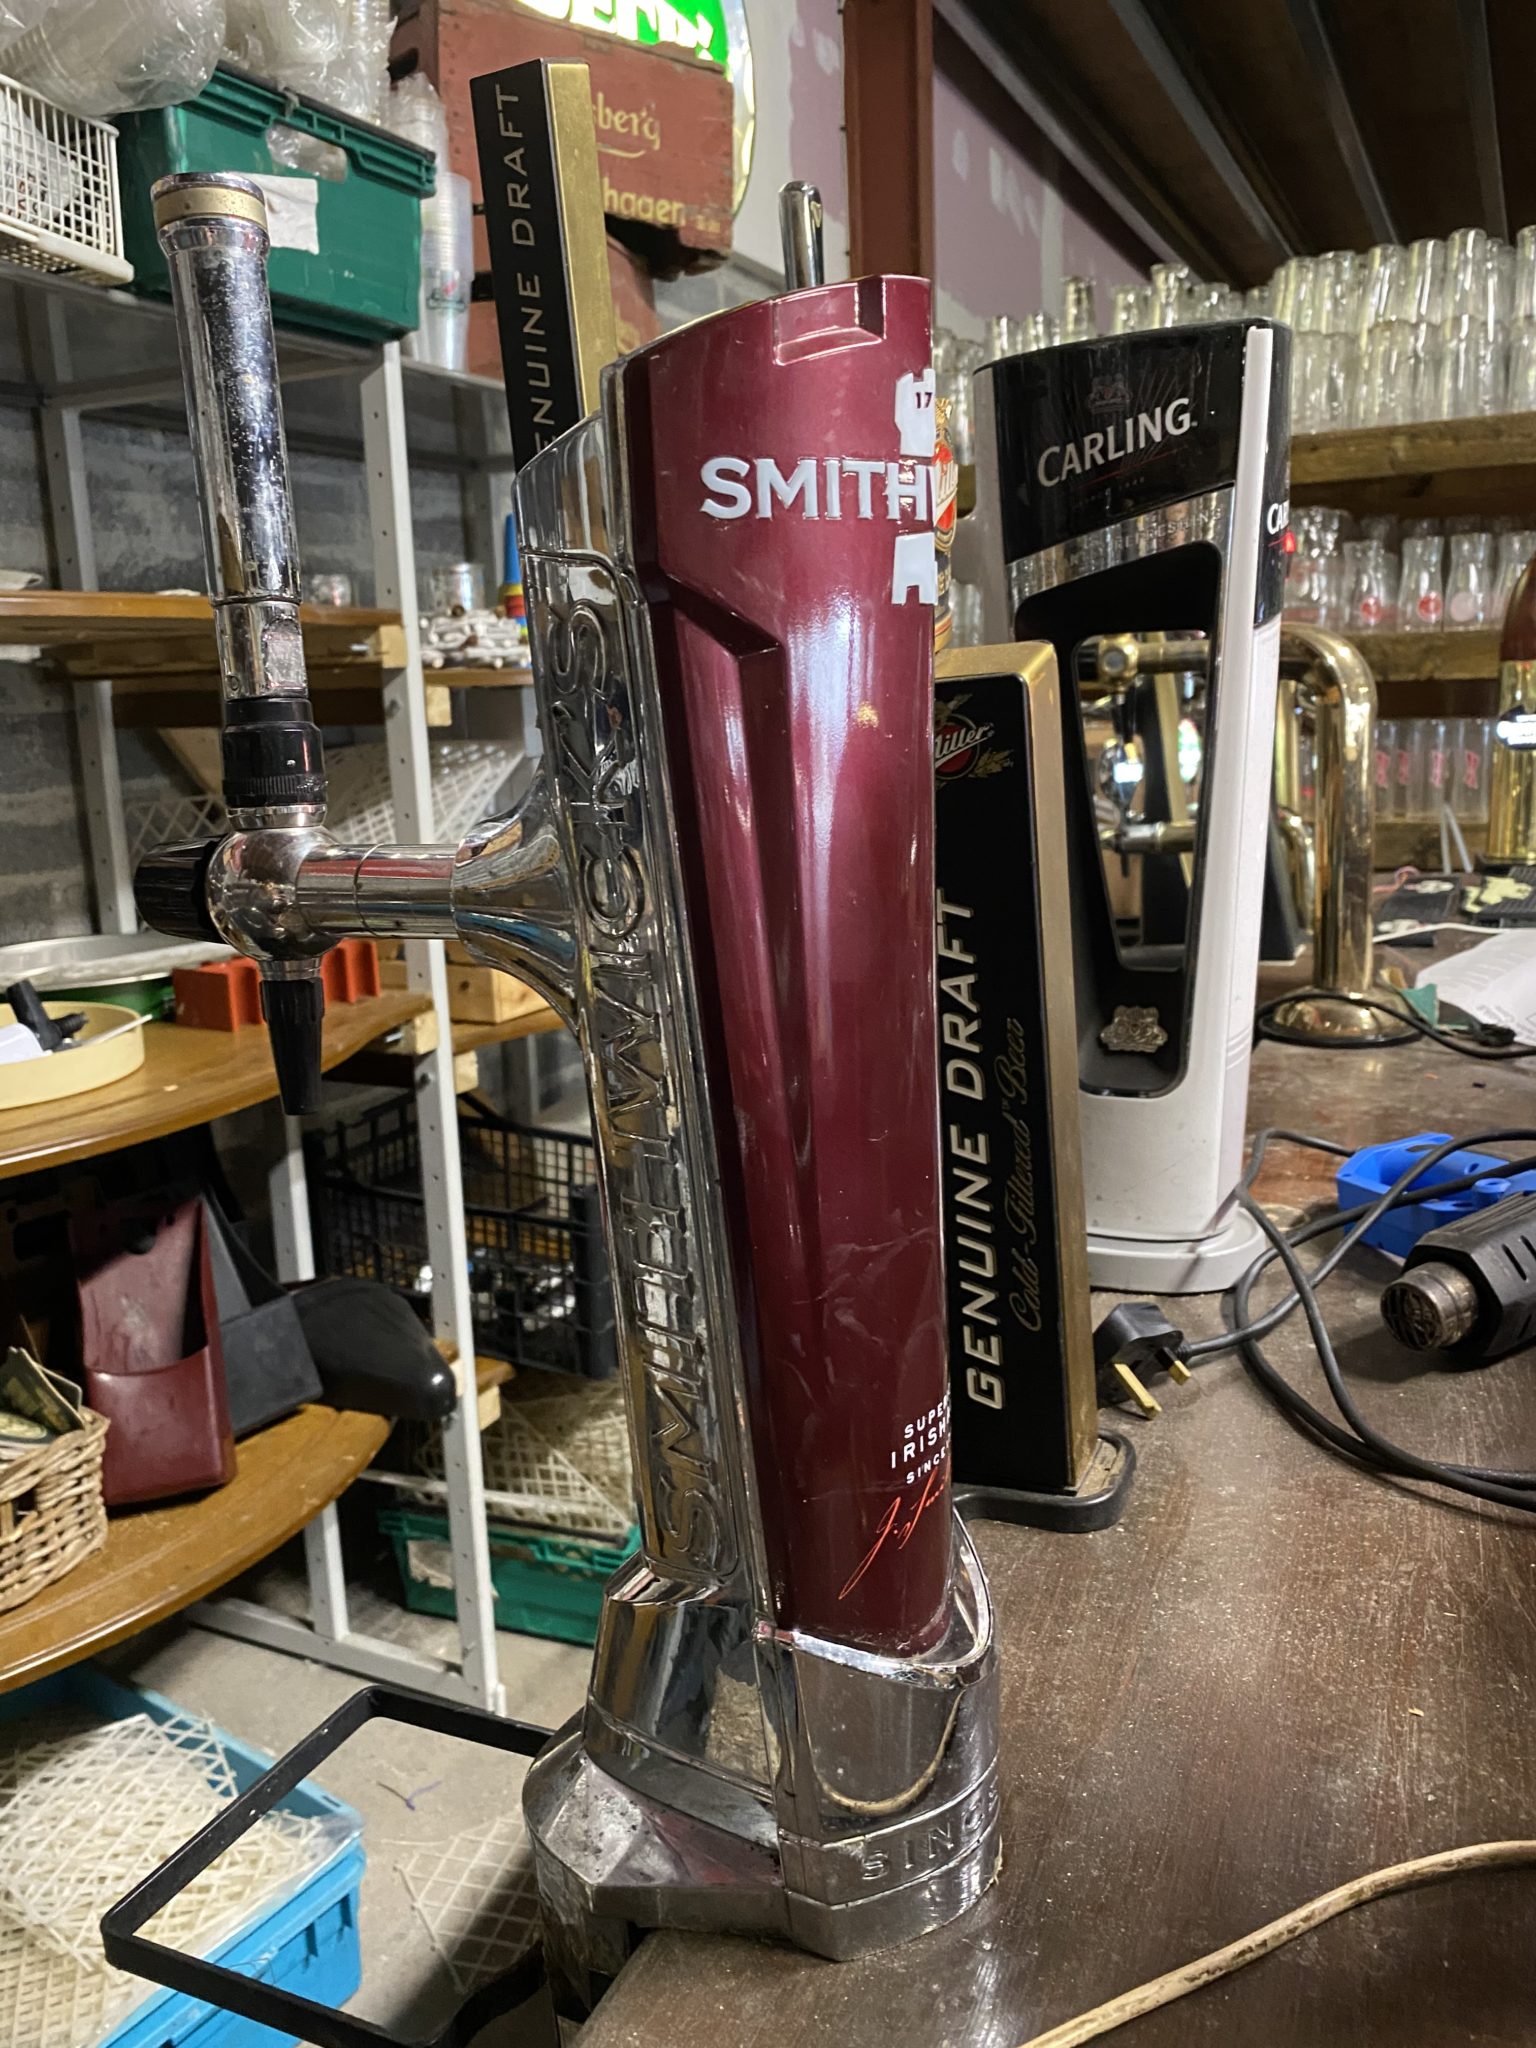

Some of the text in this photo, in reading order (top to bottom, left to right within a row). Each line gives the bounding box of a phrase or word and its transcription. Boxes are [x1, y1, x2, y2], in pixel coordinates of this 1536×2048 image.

[593, 91, 660, 150] berg
[495, 84, 536, 247] DRAFT
[1037, 398, 1192, 488] CARLING
[700, 455, 937, 526] SMITH
[936, 887, 1006, 1411] GENUINE DRAFT
[891, 1416, 946, 1469] IRISH
[906, 1446, 945, 1484] SINCE
